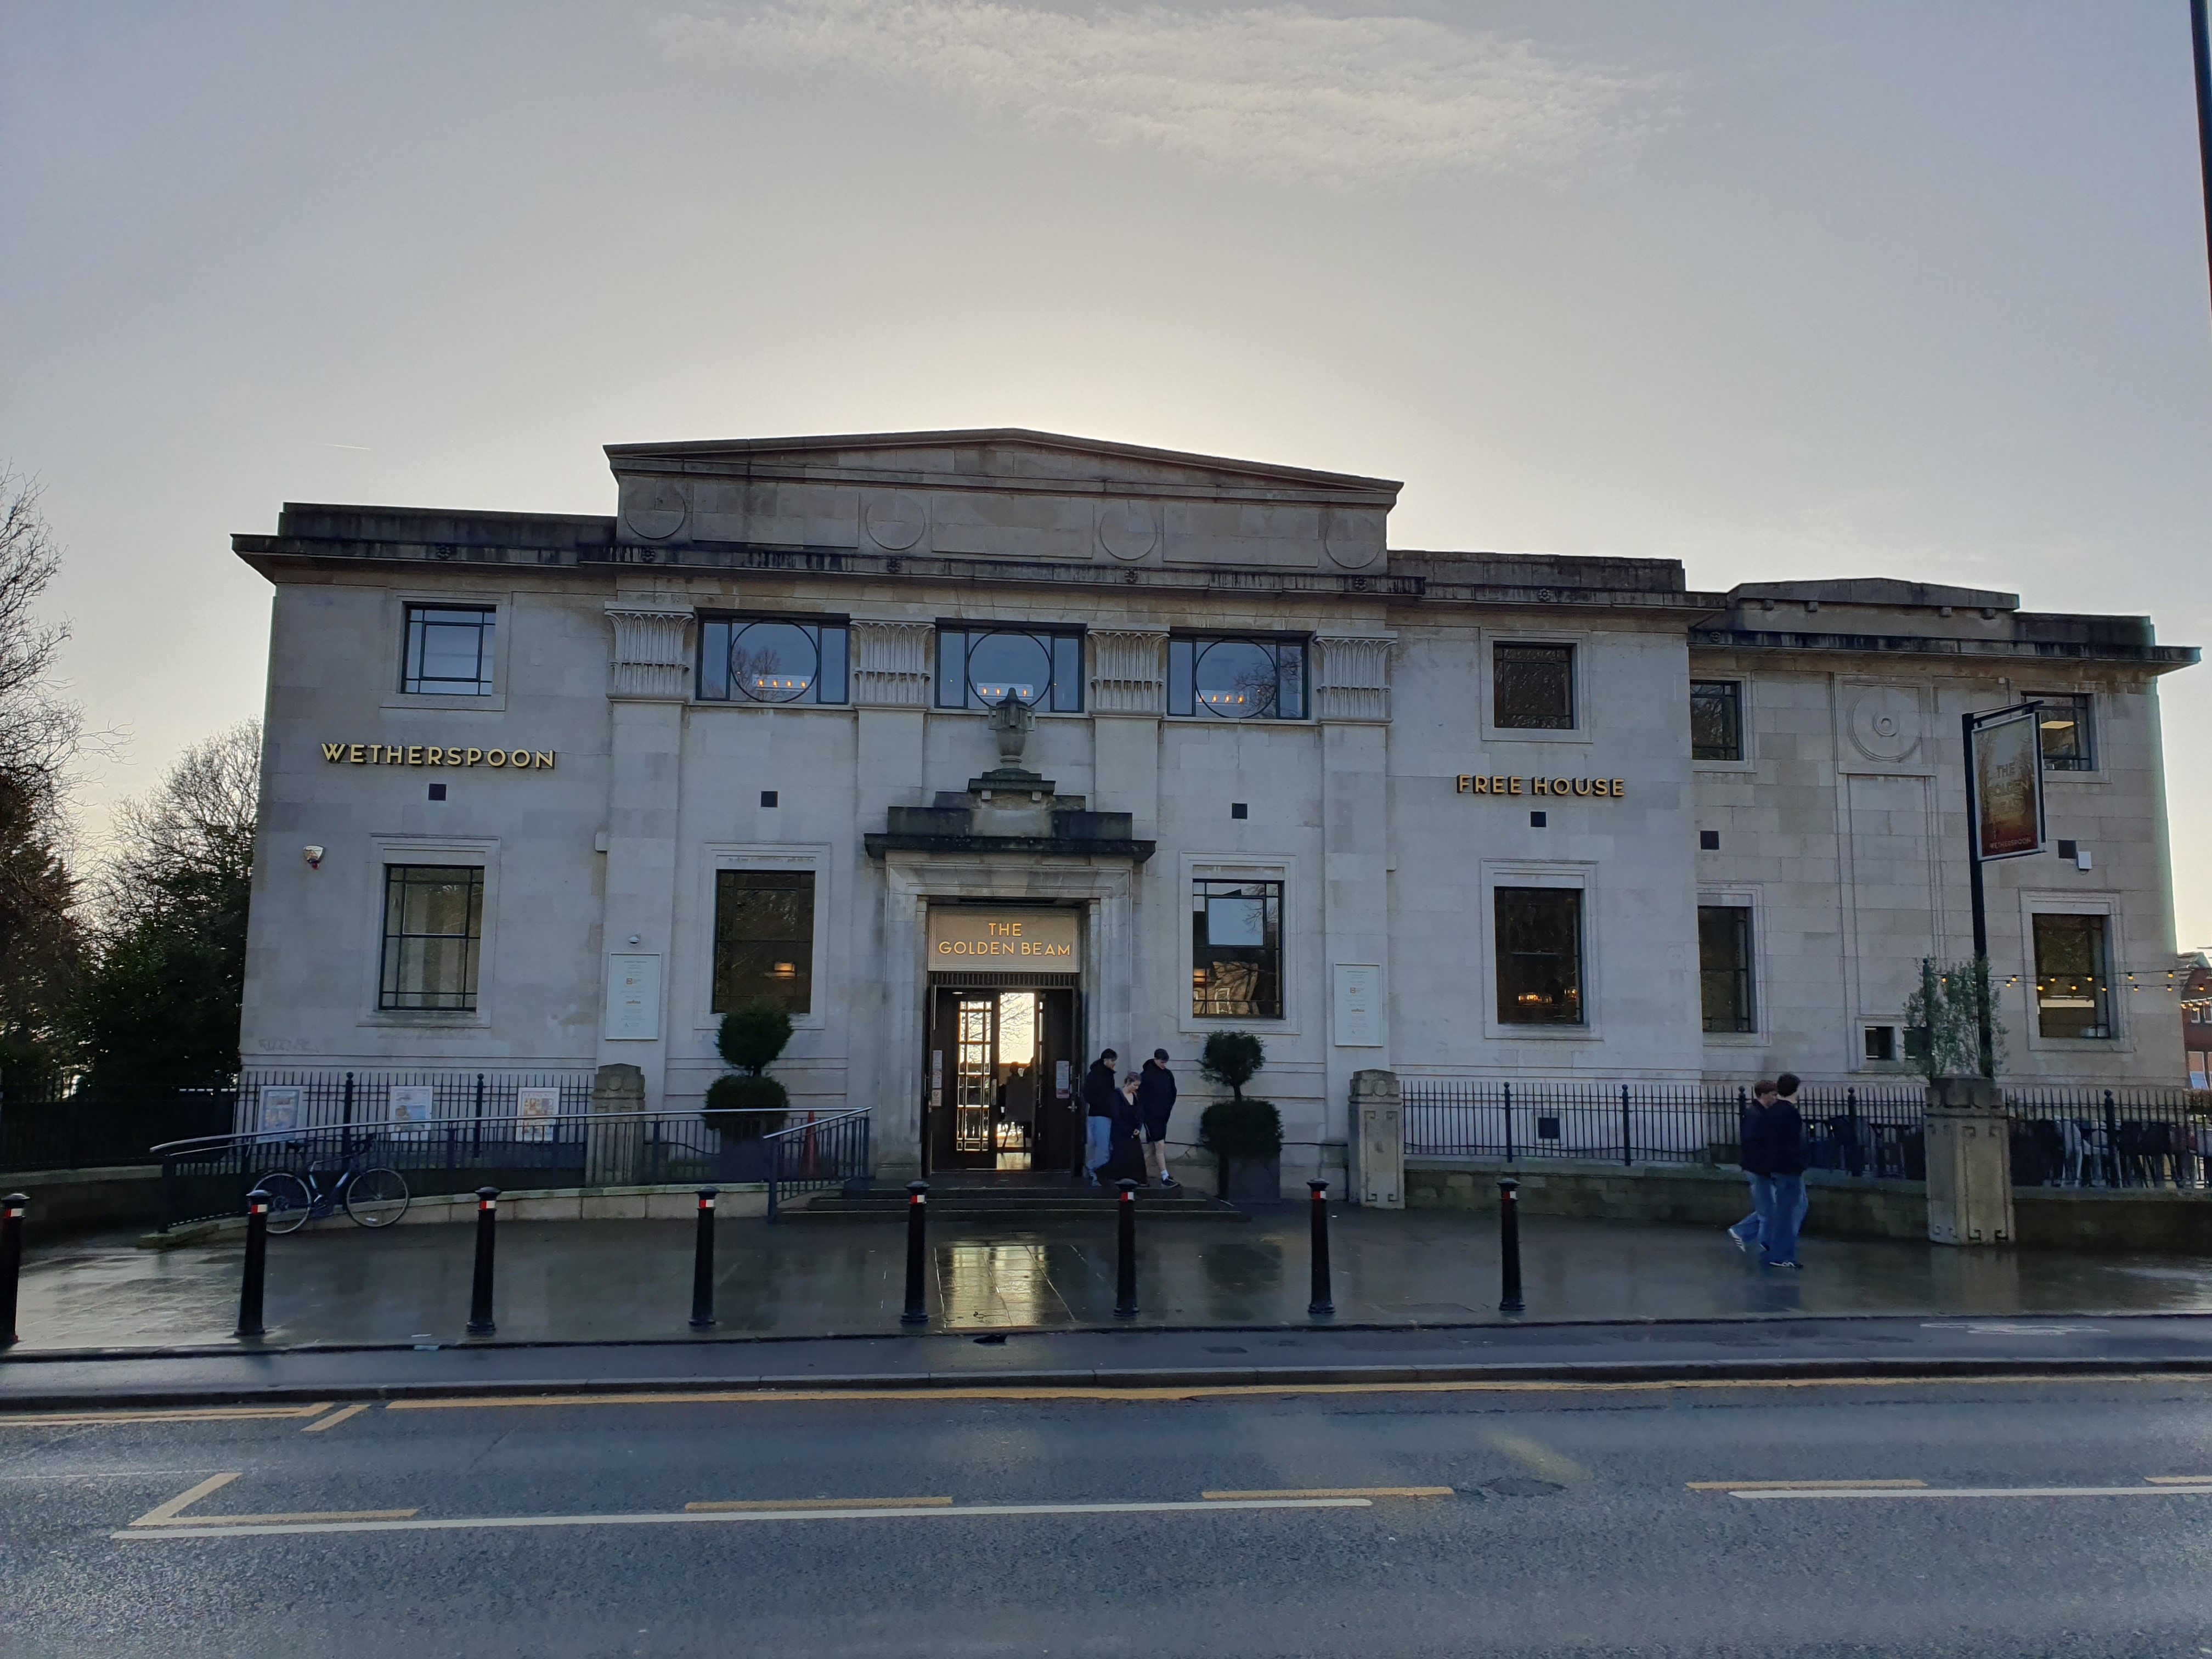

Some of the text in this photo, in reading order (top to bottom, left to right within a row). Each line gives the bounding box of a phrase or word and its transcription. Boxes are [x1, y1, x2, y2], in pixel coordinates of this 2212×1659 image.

[321, 743, 555, 769] WETHERSPOON
[1996, 762, 2015, 778] THE
[1457, 775, 1625, 797] FREE HOUSE
[989, 923, 1022, 936] THE
[939, 941, 1070, 956] GOLDEN BEAM
